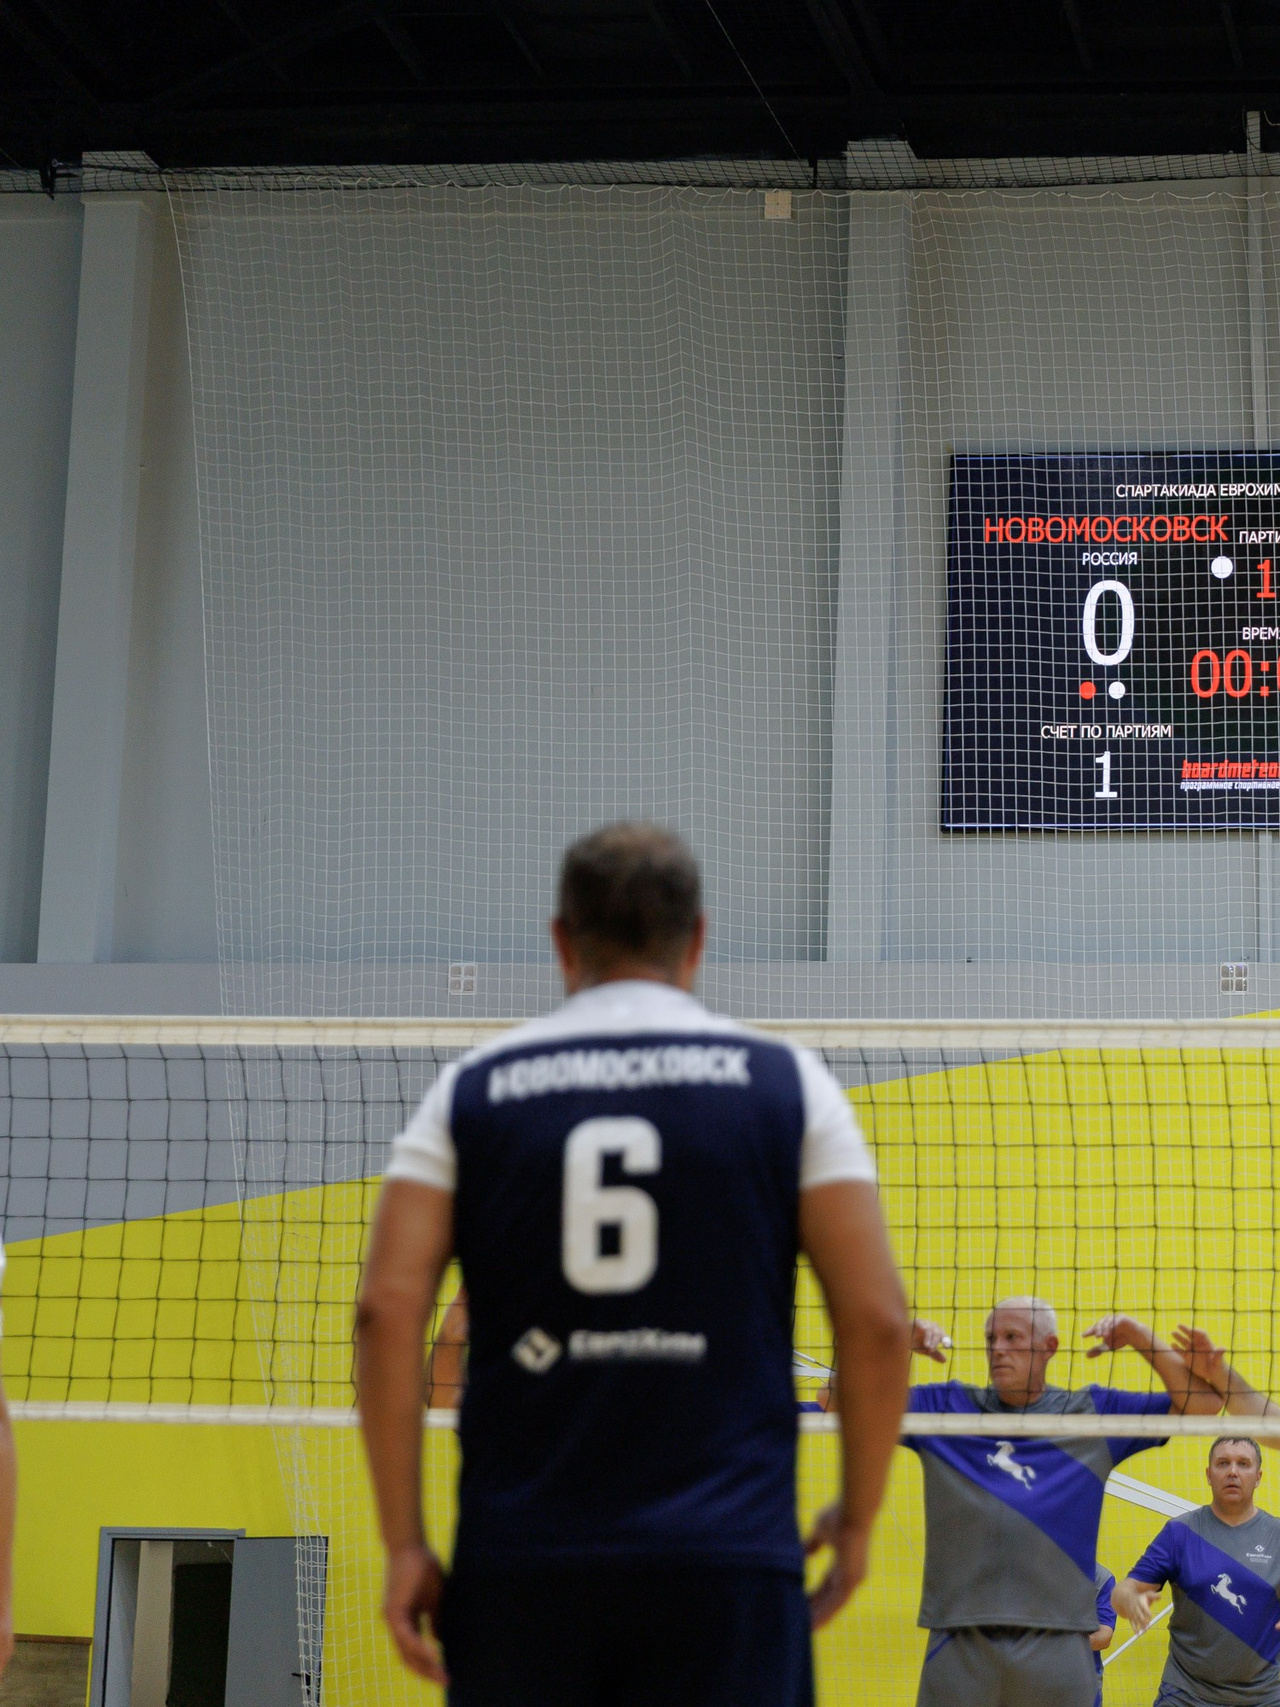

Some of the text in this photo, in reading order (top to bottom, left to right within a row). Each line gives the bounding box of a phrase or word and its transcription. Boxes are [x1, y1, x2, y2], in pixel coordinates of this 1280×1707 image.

[1115, 484, 1216, 498] СПАРТАКИАДА
[984, 515, 1228, 543] НОВОМОСКОВСК
[1082, 552, 1138, 566] РОССИЯ
[1256, 559, 1277, 599] 1
[1082, 580, 1135, 667] 0
[1040, 724, 1172, 739] СЧЕТ ПО ПАРТИЯМ
[1094, 750, 1118, 798] 1
[488, 1045, 750, 1104] НОВОМОСКОВСК
[561, 1115, 662, 1295] 6
